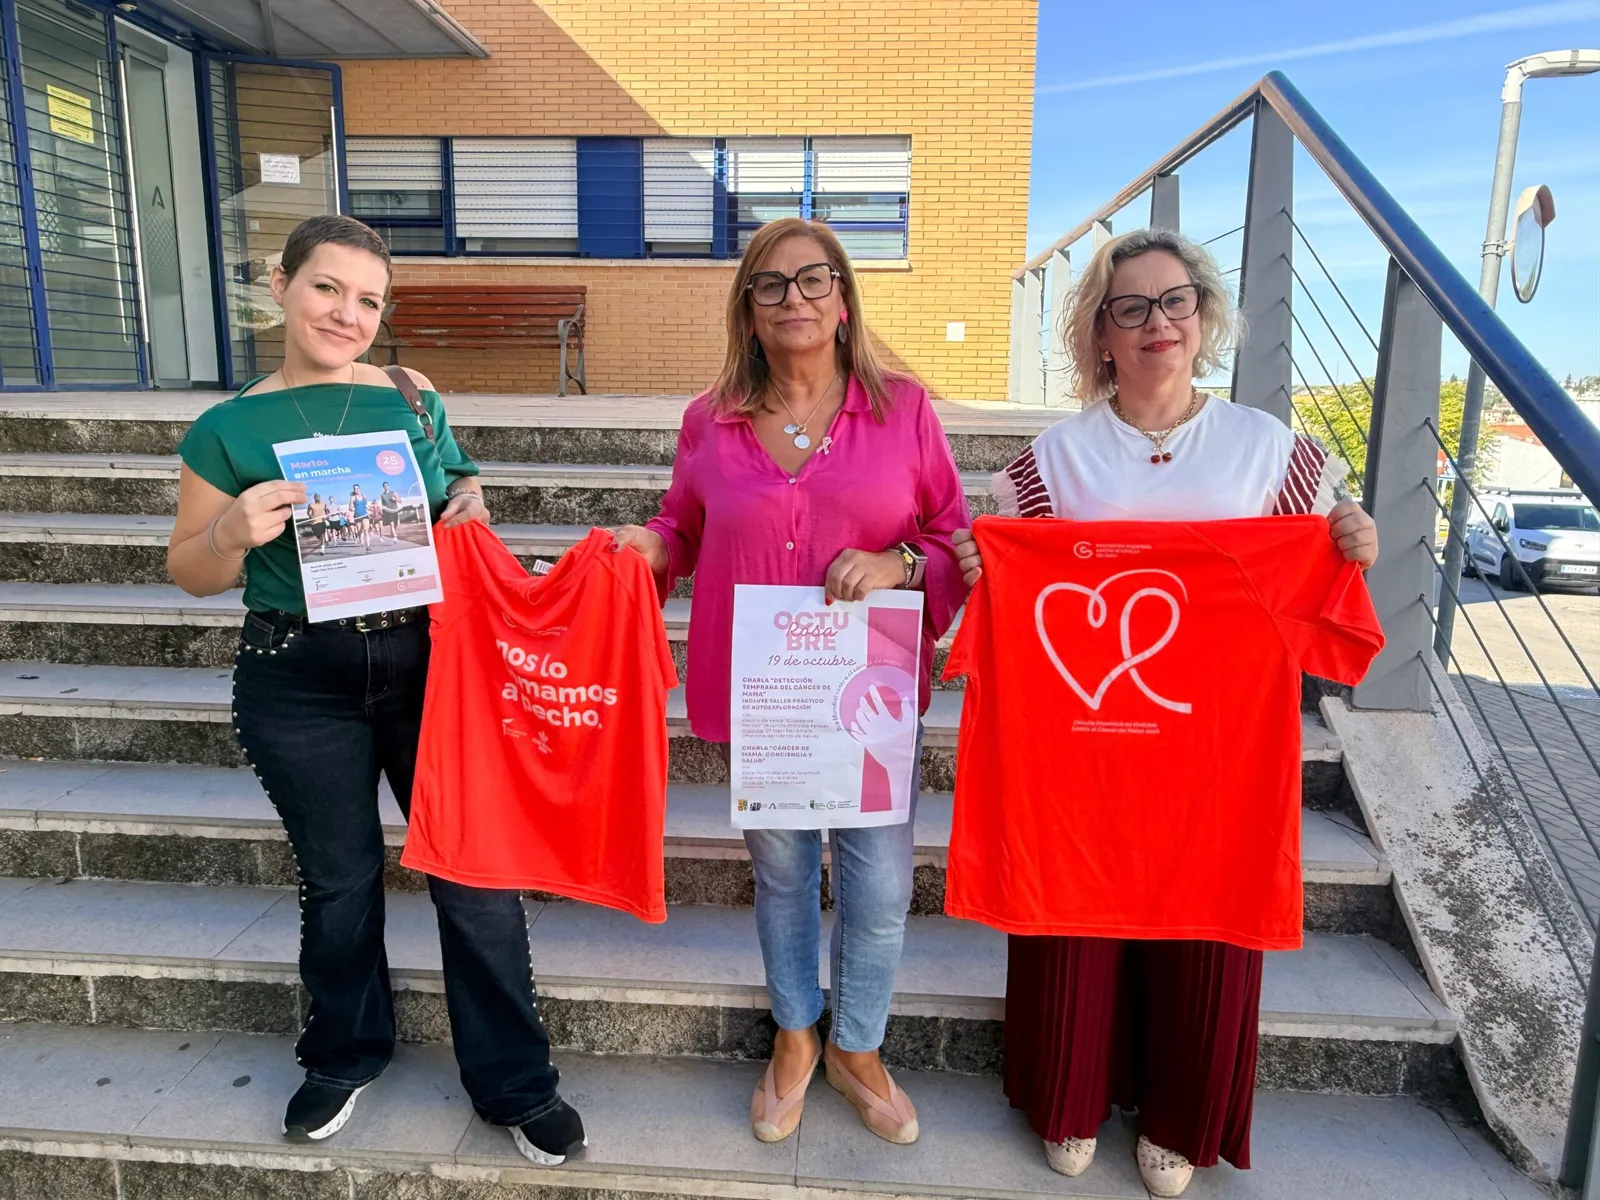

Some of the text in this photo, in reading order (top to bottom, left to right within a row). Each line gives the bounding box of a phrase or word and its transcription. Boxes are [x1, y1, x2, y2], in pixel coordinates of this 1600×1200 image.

[290, 459, 329, 470] Martos
[382, 455, 398, 465] 25
[294, 471, 308, 480] en
[310, 466, 352, 477] marcha
[773, 611, 849, 630] OCTU
[786, 622, 838, 637] Rosa
[786, 633, 837, 651] BRE
[496, 638, 568, 679] nos lo
[768, 655, 857, 666] 19 de octubre
[502, 682, 519, 702] a
[508, 671, 618, 705] mamos
